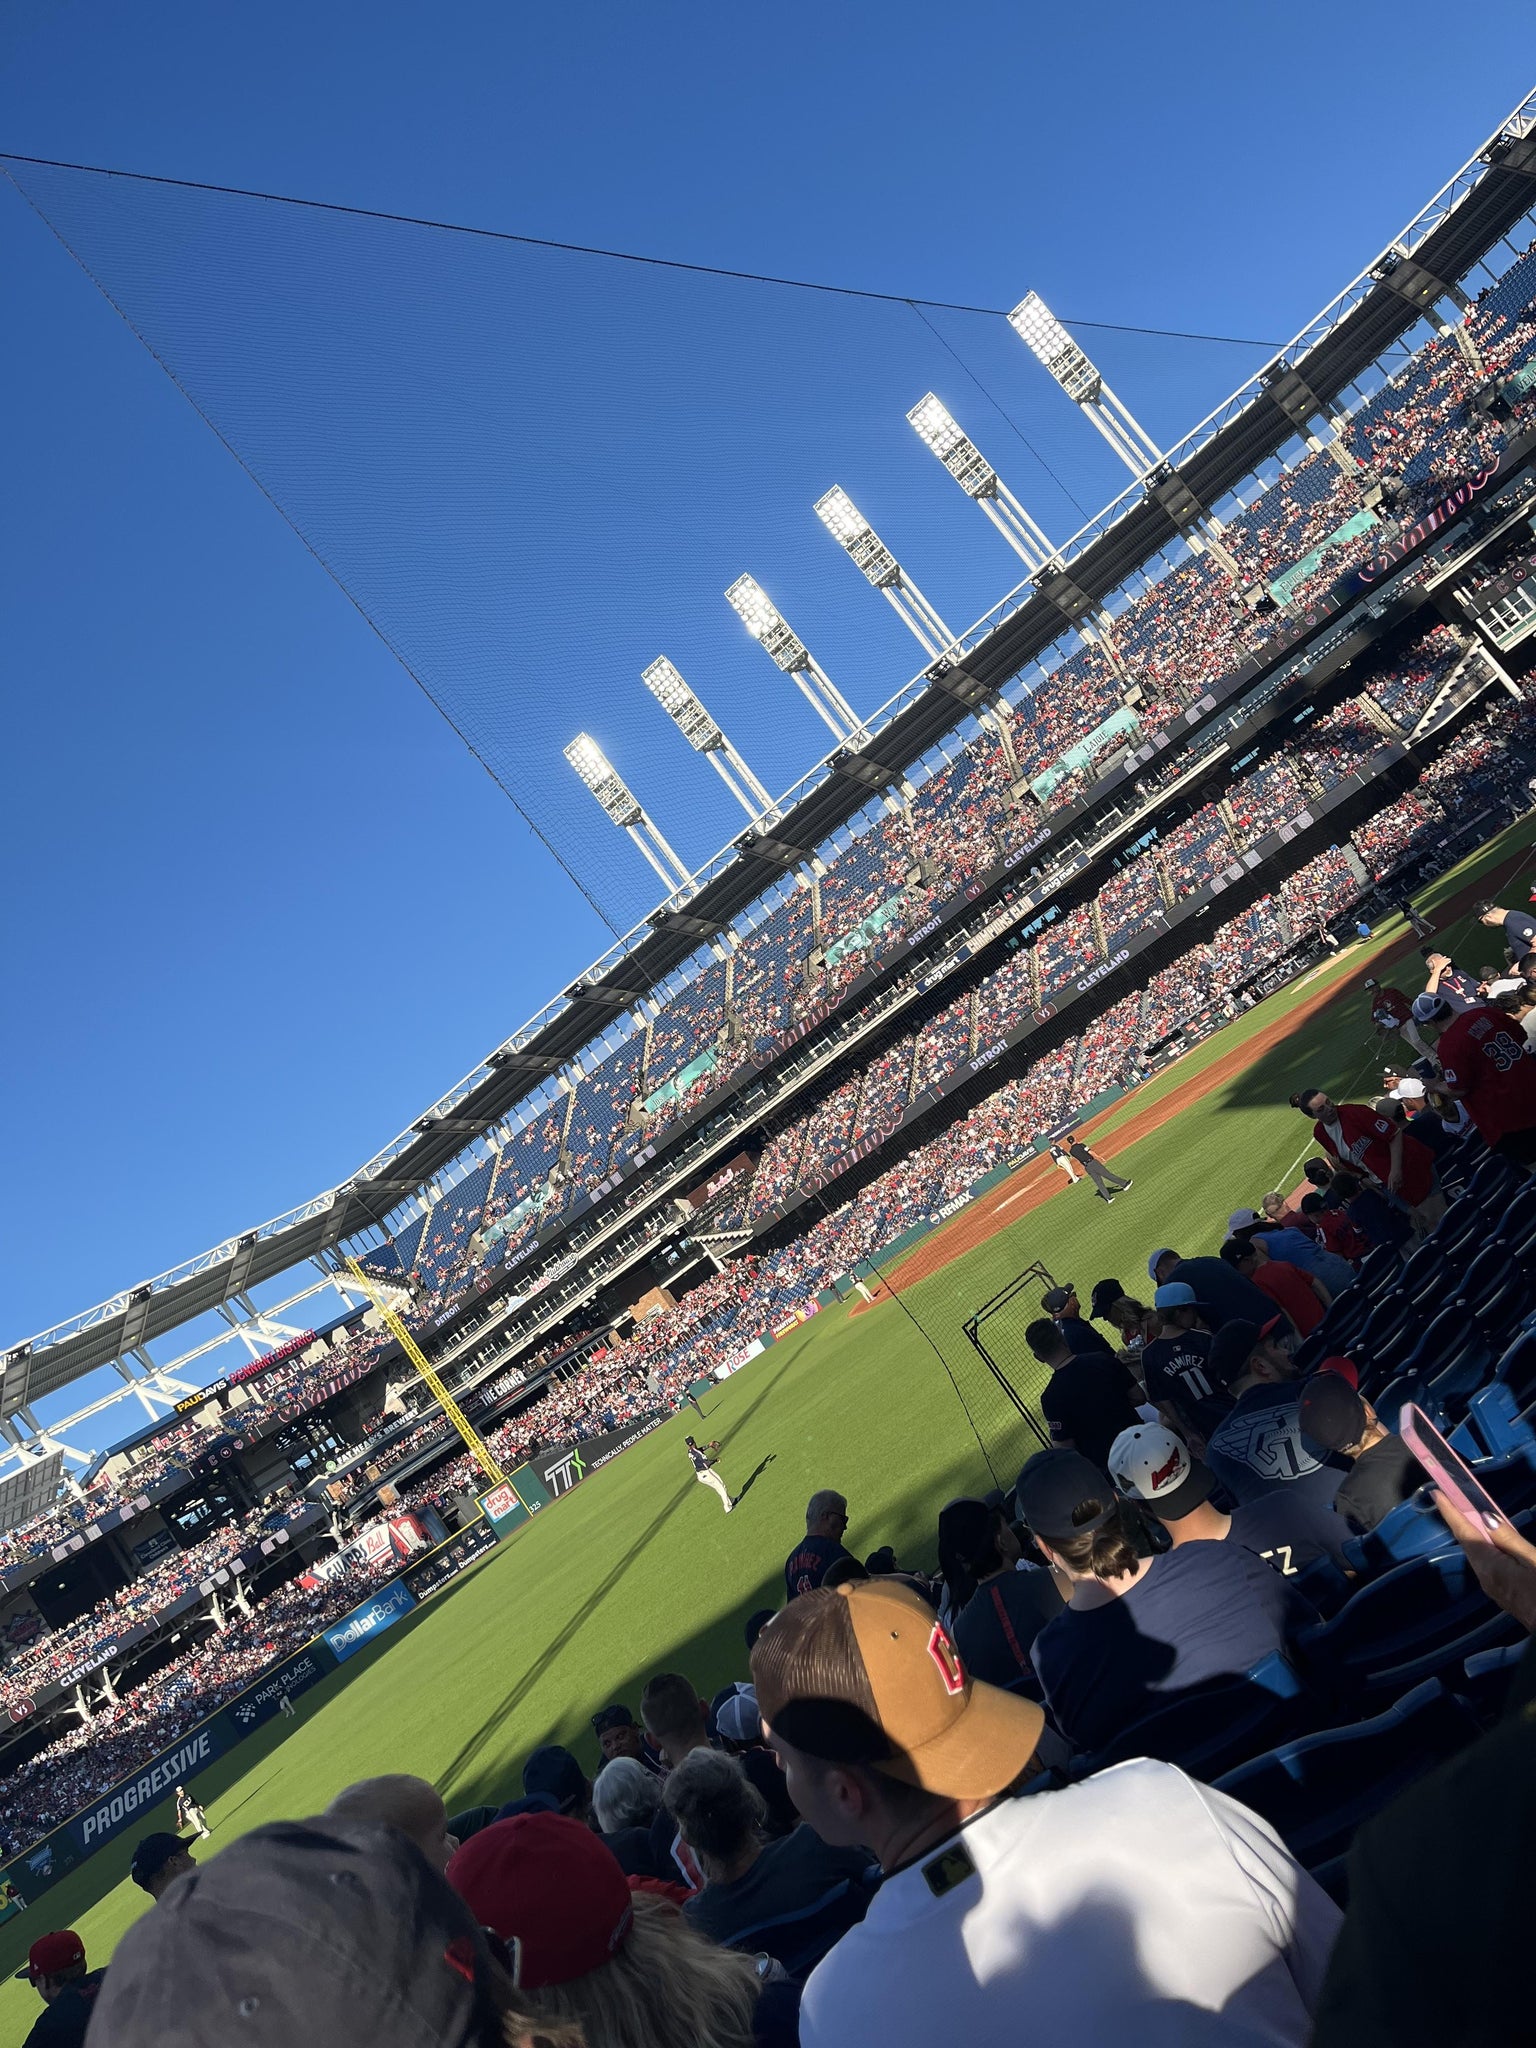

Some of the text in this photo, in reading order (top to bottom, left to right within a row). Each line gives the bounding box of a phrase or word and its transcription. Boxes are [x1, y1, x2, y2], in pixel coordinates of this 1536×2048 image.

[1004, 828, 1052, 869] CLEVELAND
[968, 885, 980, 895] VS
[1041, 876, 1060, 895] drug
[1059, 861, 1080, 881] mart
[907, 915, 943, 946] DETROIT
[924, 968, 943, 987] drug
[942, 957, 961, 975] mart
[1076, 949, 1130, 991] CLEVELAND
[1038, 1008, 1050, 1019] VS
[969, 1038, 1009, 1071] DETROIT
[1482, 1031, 1523, 1072] 38
[504, 1240, 540, 1271] CLEVELAND
[434, 1303, 461, 1327] DETROIT
[228, 1328, 318, 1385] PENNANT DISTRICT
[726, 1348, 750, 1374] ROSE
[480, 1369, 527, 1406] THE CORNER
[1179, 1367, 1214, 1401] 11
[336, 1450, 351, 1465] FAT
[383, 1409, 419, 1435] BREWERY
[591, 1417, 663, 1469] TECHNICALLY, PEOPLE MATTER
[486, 1491, 509, 1510] drug
[493, 1496, 518, 1517] mart
[529, 1500, 542, 1513] 325
[366, 1532, 385, 1555] Ball
[60, 1645, 118, 1687] CLEVELAND
[255, 1657, 313, 1705] PARK PLACE
[15, 1704, 28, 1716] VS
[82, 1732, 211, 1845] PROGRESSIVE
